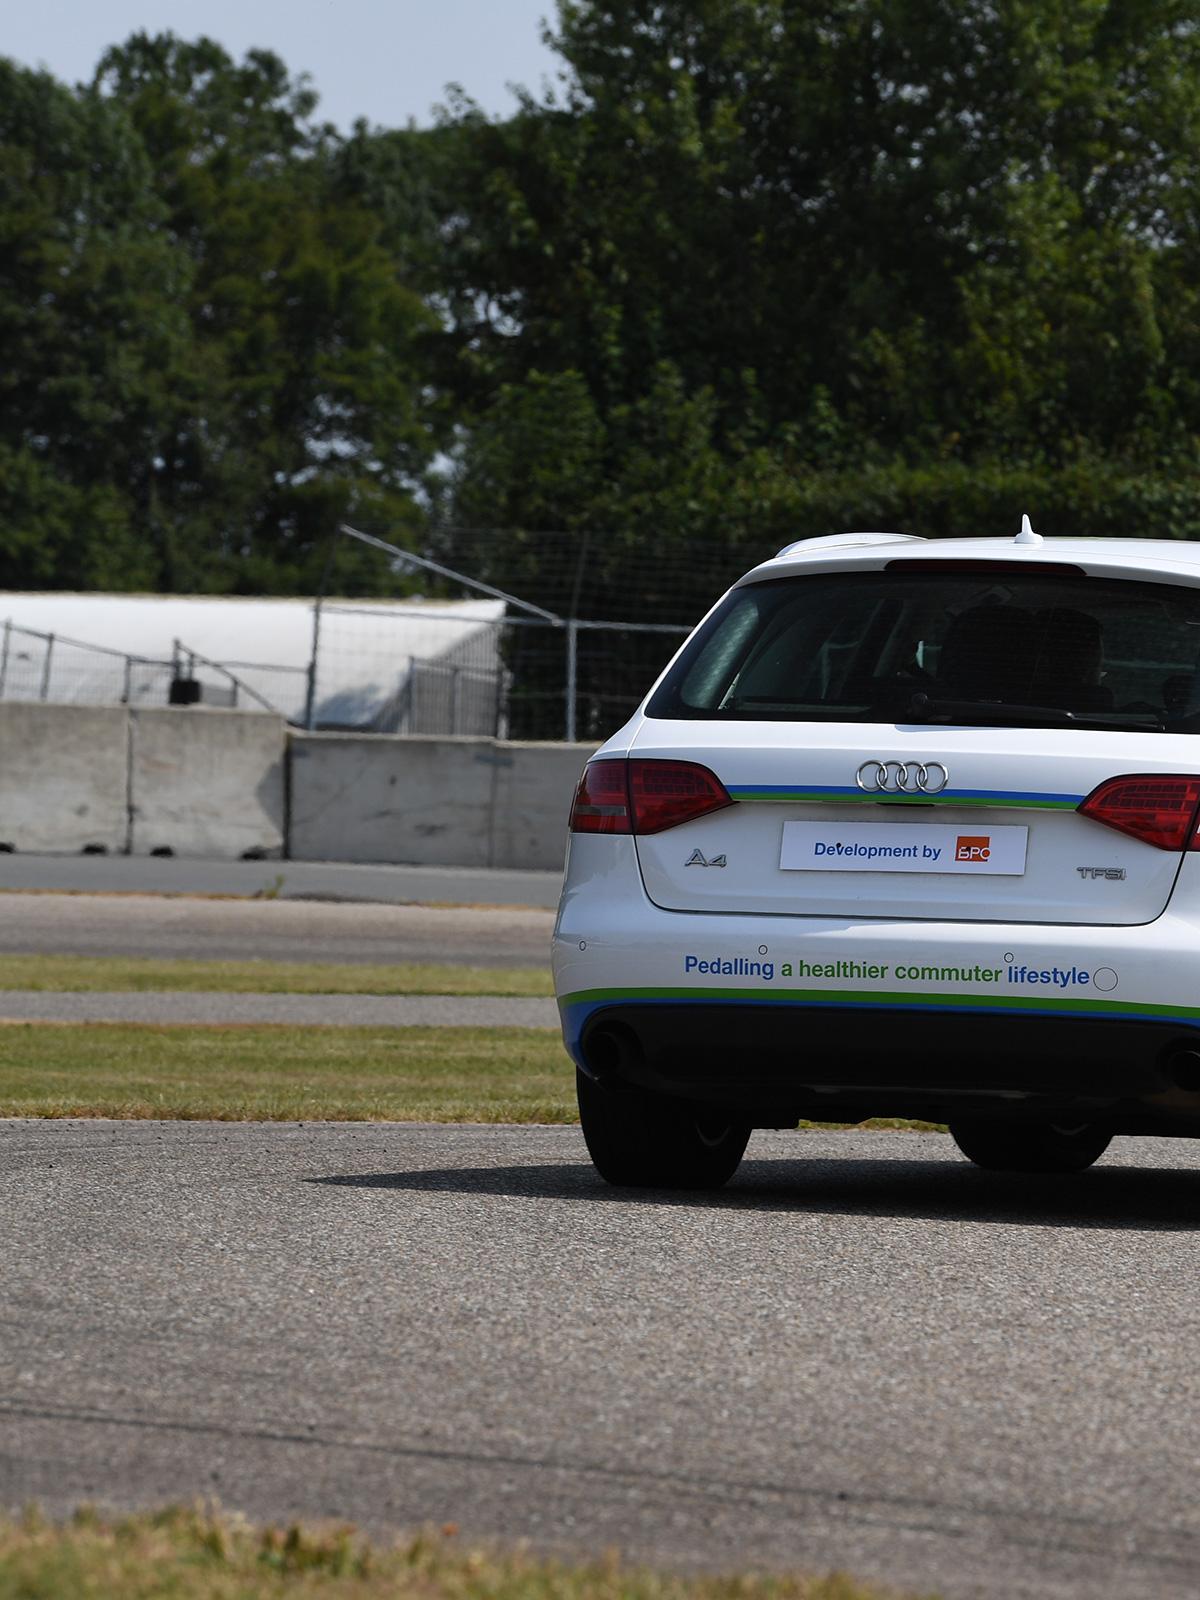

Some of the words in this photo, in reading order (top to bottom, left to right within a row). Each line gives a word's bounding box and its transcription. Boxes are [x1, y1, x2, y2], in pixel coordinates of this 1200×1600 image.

[684, 848, 727, 868] A4
[814, 842, 918, 859] Development
[922, 845, 941, 860] by
[1076, 867, 1126, 880] TFSI
[685, 956, 774, 980] Pedalling
[781, 964, 792, 977] a
[799, 960, 888, 979] healthier
[894, 965, 1003, 982] commuter
[1008, 966, 1090, 988] lifestyle
